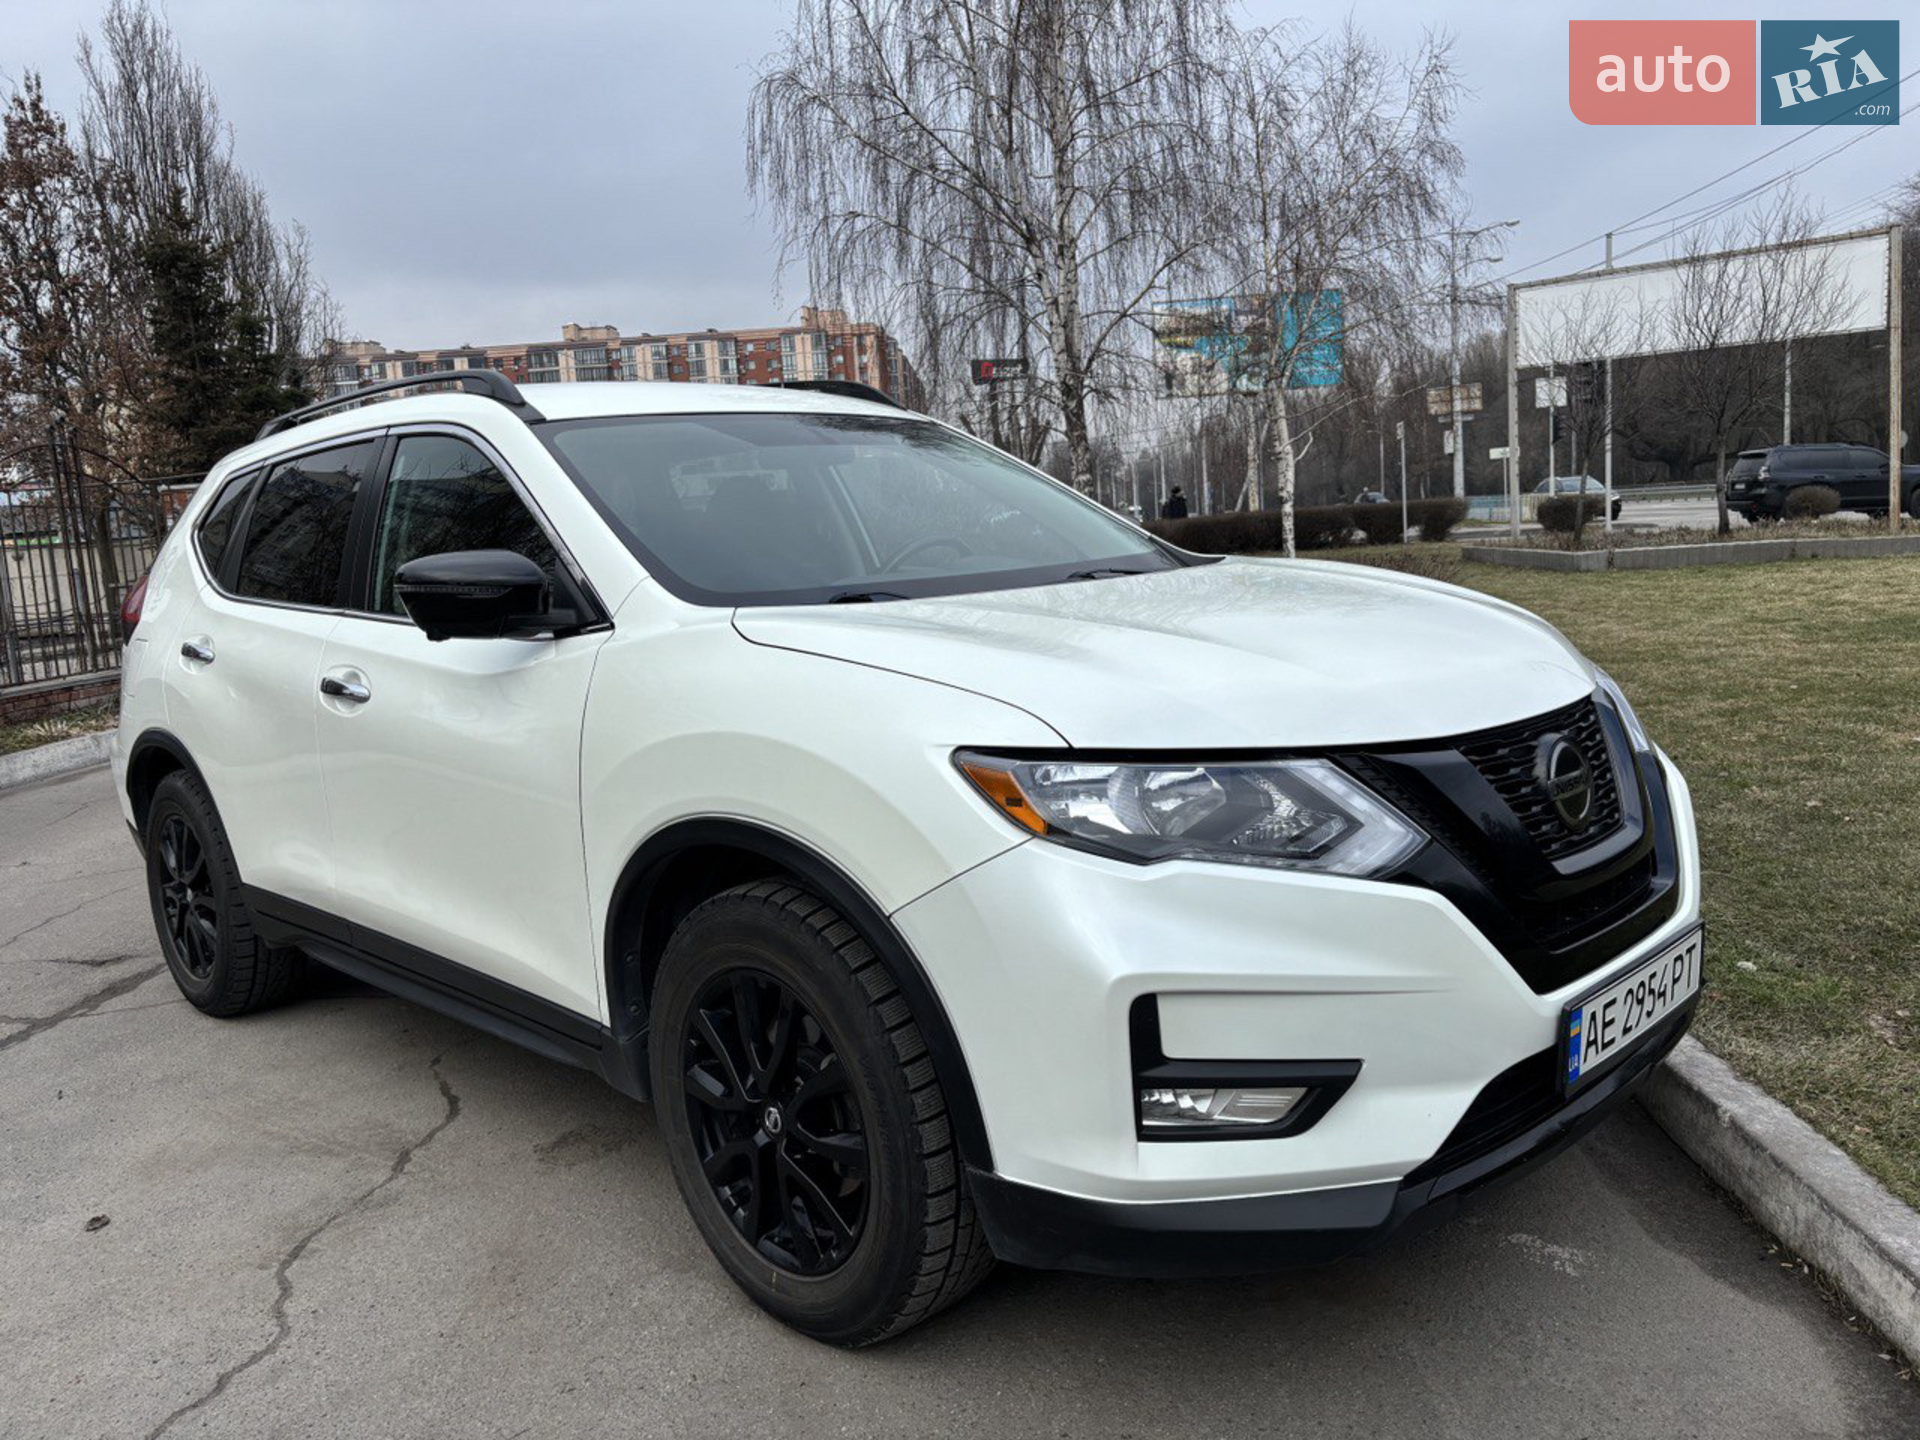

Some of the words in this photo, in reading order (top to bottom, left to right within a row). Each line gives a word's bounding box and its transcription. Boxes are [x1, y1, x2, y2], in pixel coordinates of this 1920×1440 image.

[1583, 997, 1618, 1063] AE
[1621, 963, 1668, 1038] 2954
[1670, 943, 1697, 1001] PT
